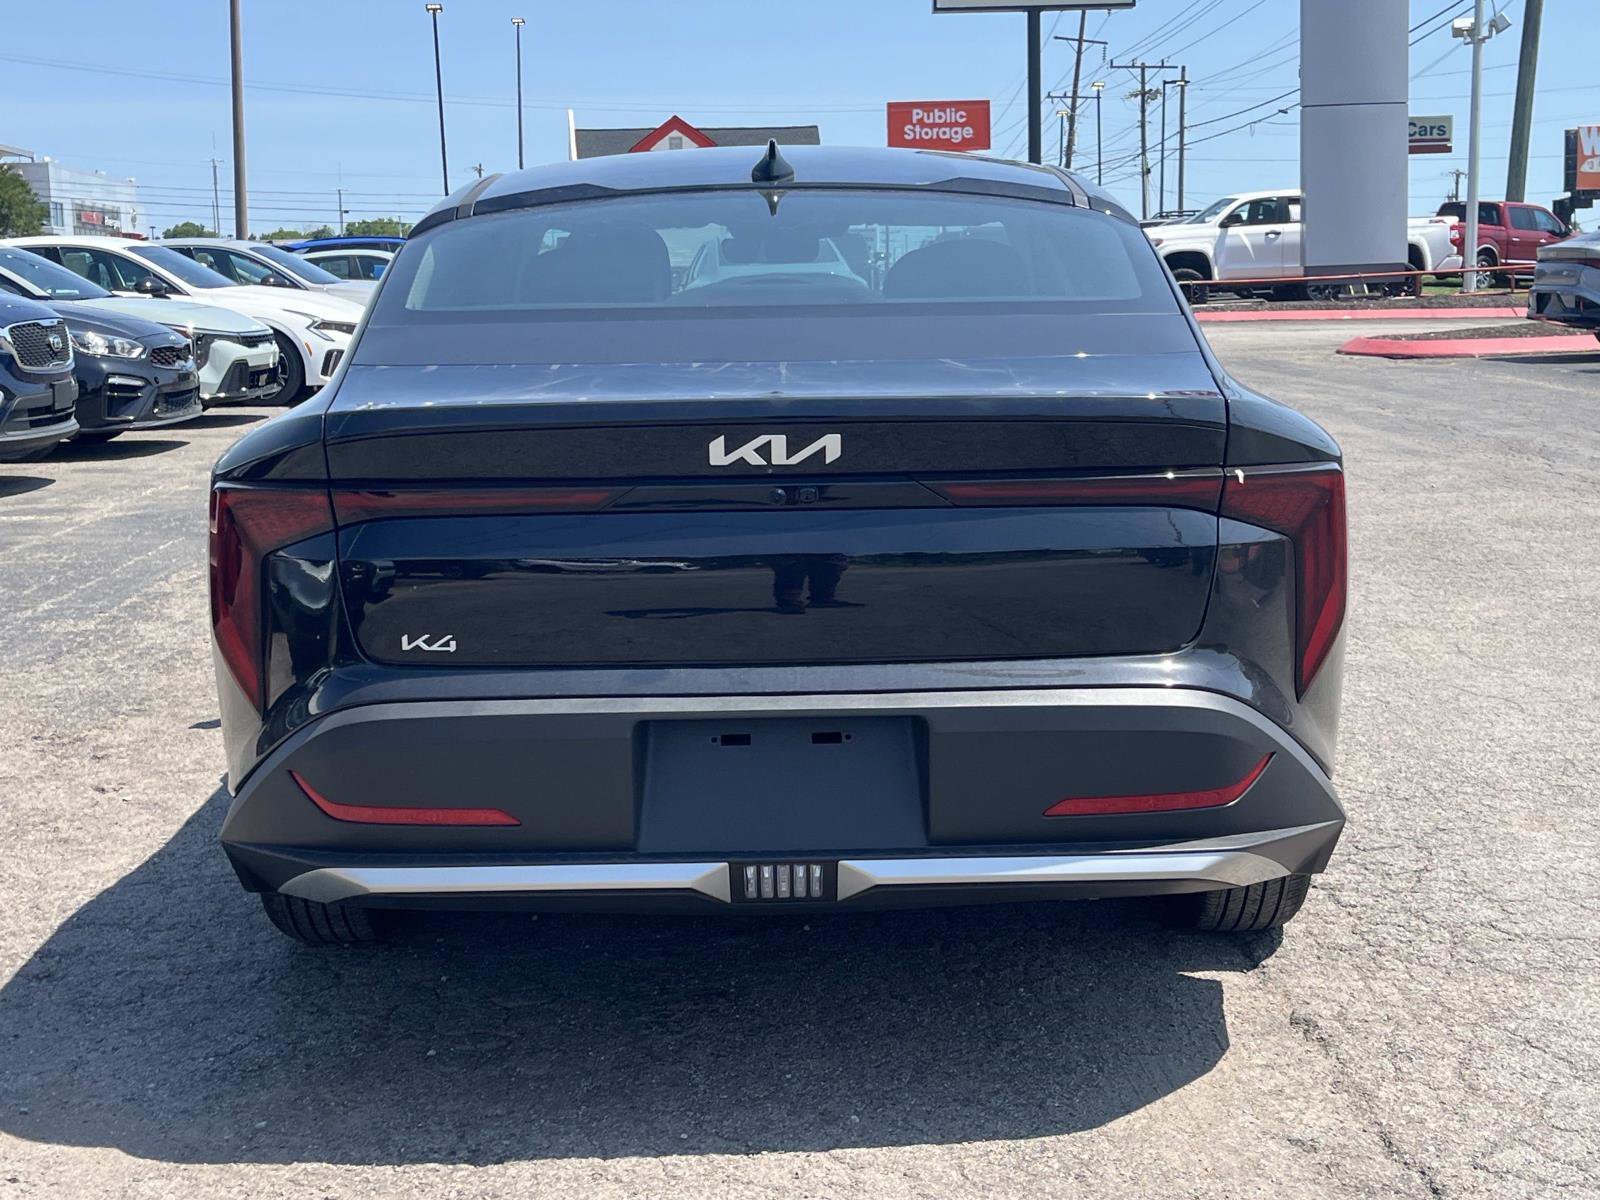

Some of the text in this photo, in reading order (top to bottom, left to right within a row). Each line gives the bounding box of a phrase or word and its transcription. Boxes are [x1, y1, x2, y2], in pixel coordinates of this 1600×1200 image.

[912, 108, 967, 124] Public
[903, 124, 974, 143] Storage
[1408, 121, 1447, 137] Cars
[708, 433, 842, 466] KIA
[401, 634, 457, 652] K4
